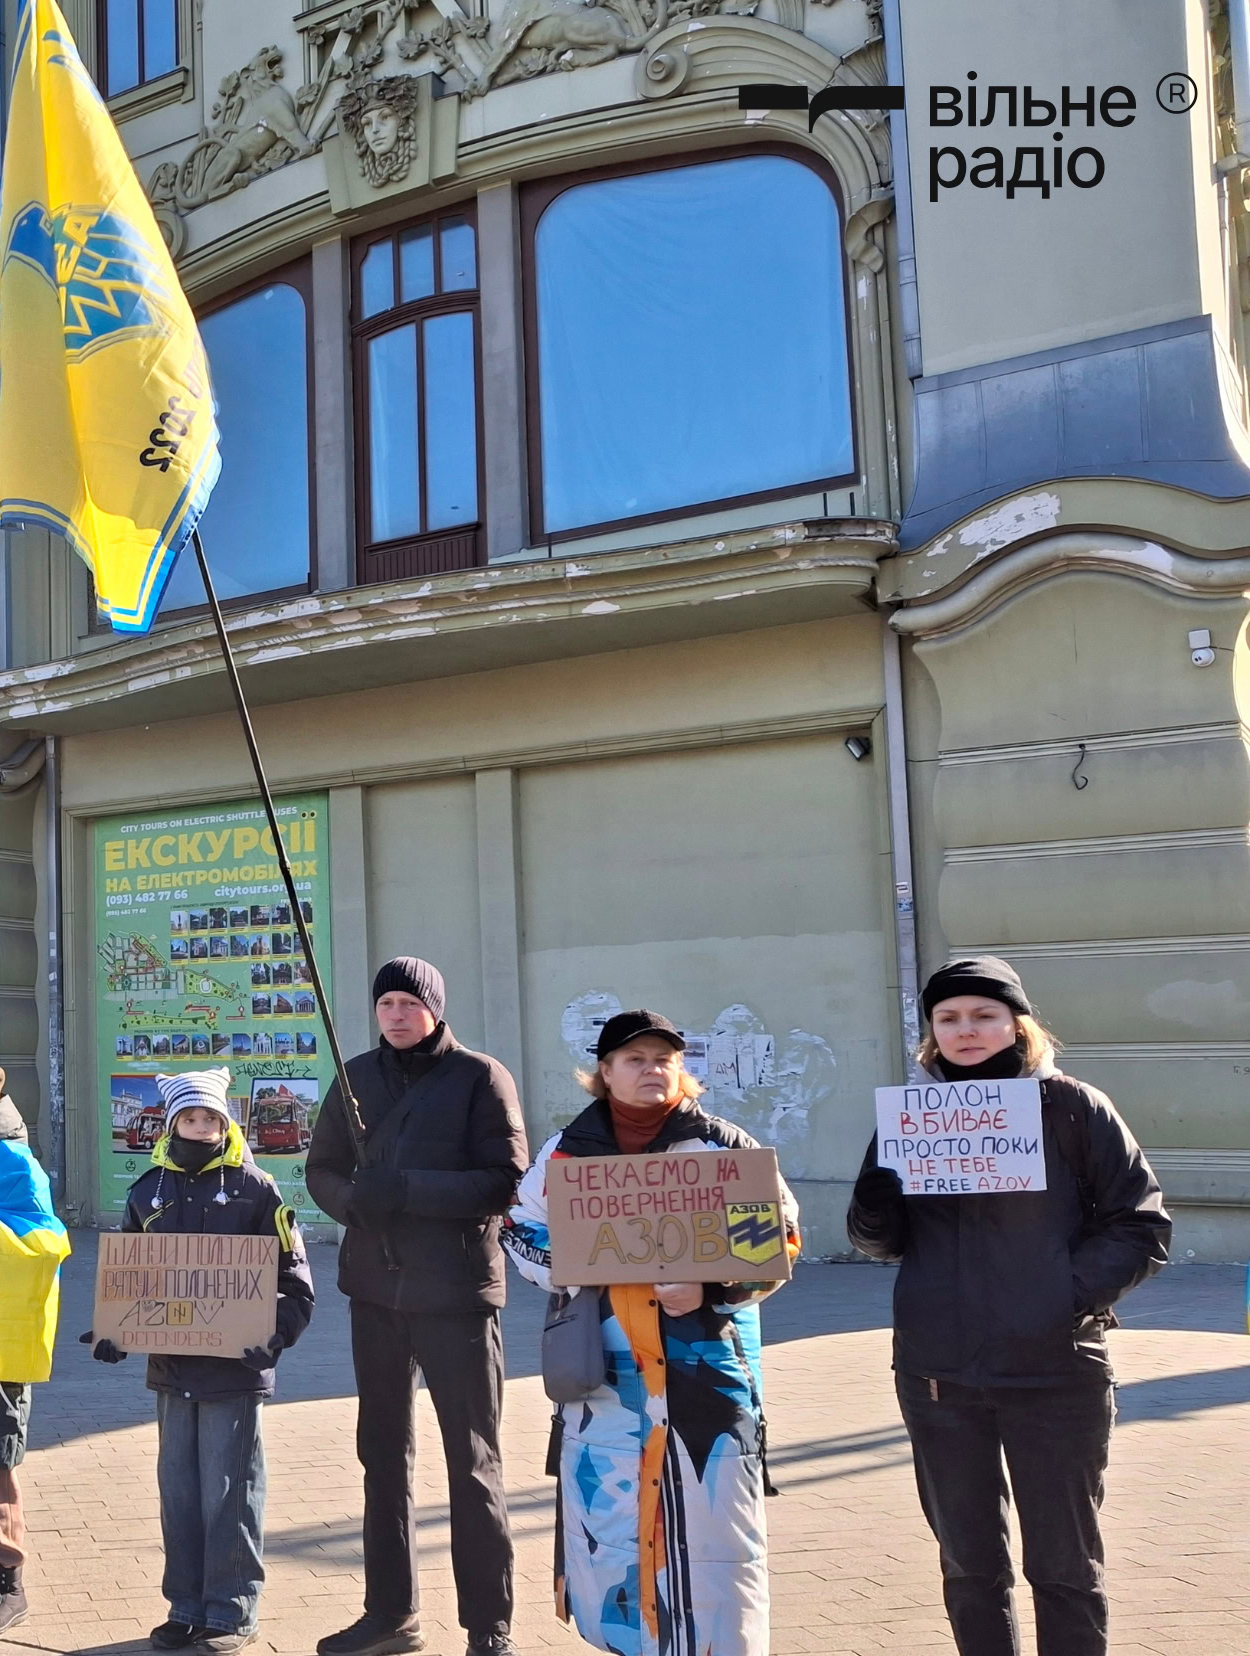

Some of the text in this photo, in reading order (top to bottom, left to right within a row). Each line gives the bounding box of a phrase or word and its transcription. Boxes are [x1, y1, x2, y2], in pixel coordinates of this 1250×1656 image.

[120, 806, 298, 833] CITY TOURS ON ELECTRIC SHUTTLE USES
[104, 810, 318, 872] ЕКСКУРСІЇ
[106, 877, 132, 893] НА
[106, 880, 312, 908] (093) 482 77 66 citytours.orua
[904, 1084, 1002, 1111] ПОЛОН
[900, 1108, 1008, 1135] ВБИВАЄ
[884, 1136, 1038, 1159] ПРОСТО ПОКИ
[564, 1157, 741, 1192] ЧЕКАЄМО НА
[908, 1156, 998, 1175] НЕ ТЕБЕ
[910, 1176, 1032, 1192] #FREE AZOV
[570, 1186, 726, 1220] ПОВЕРНЕННЯ
[730, 1203, 771, 1214] АЗОВ
[106, 1235, 276, 1265] ШАНУЙ ПОЛЕГЛИХ
[588, 1211, 729, 1266] АЗОВ
[104, 1269, 263, 1300] РЯТУЙ ПОЛОНЕНИХ
[122, 1331, 222, 1347] DEFENDERS
